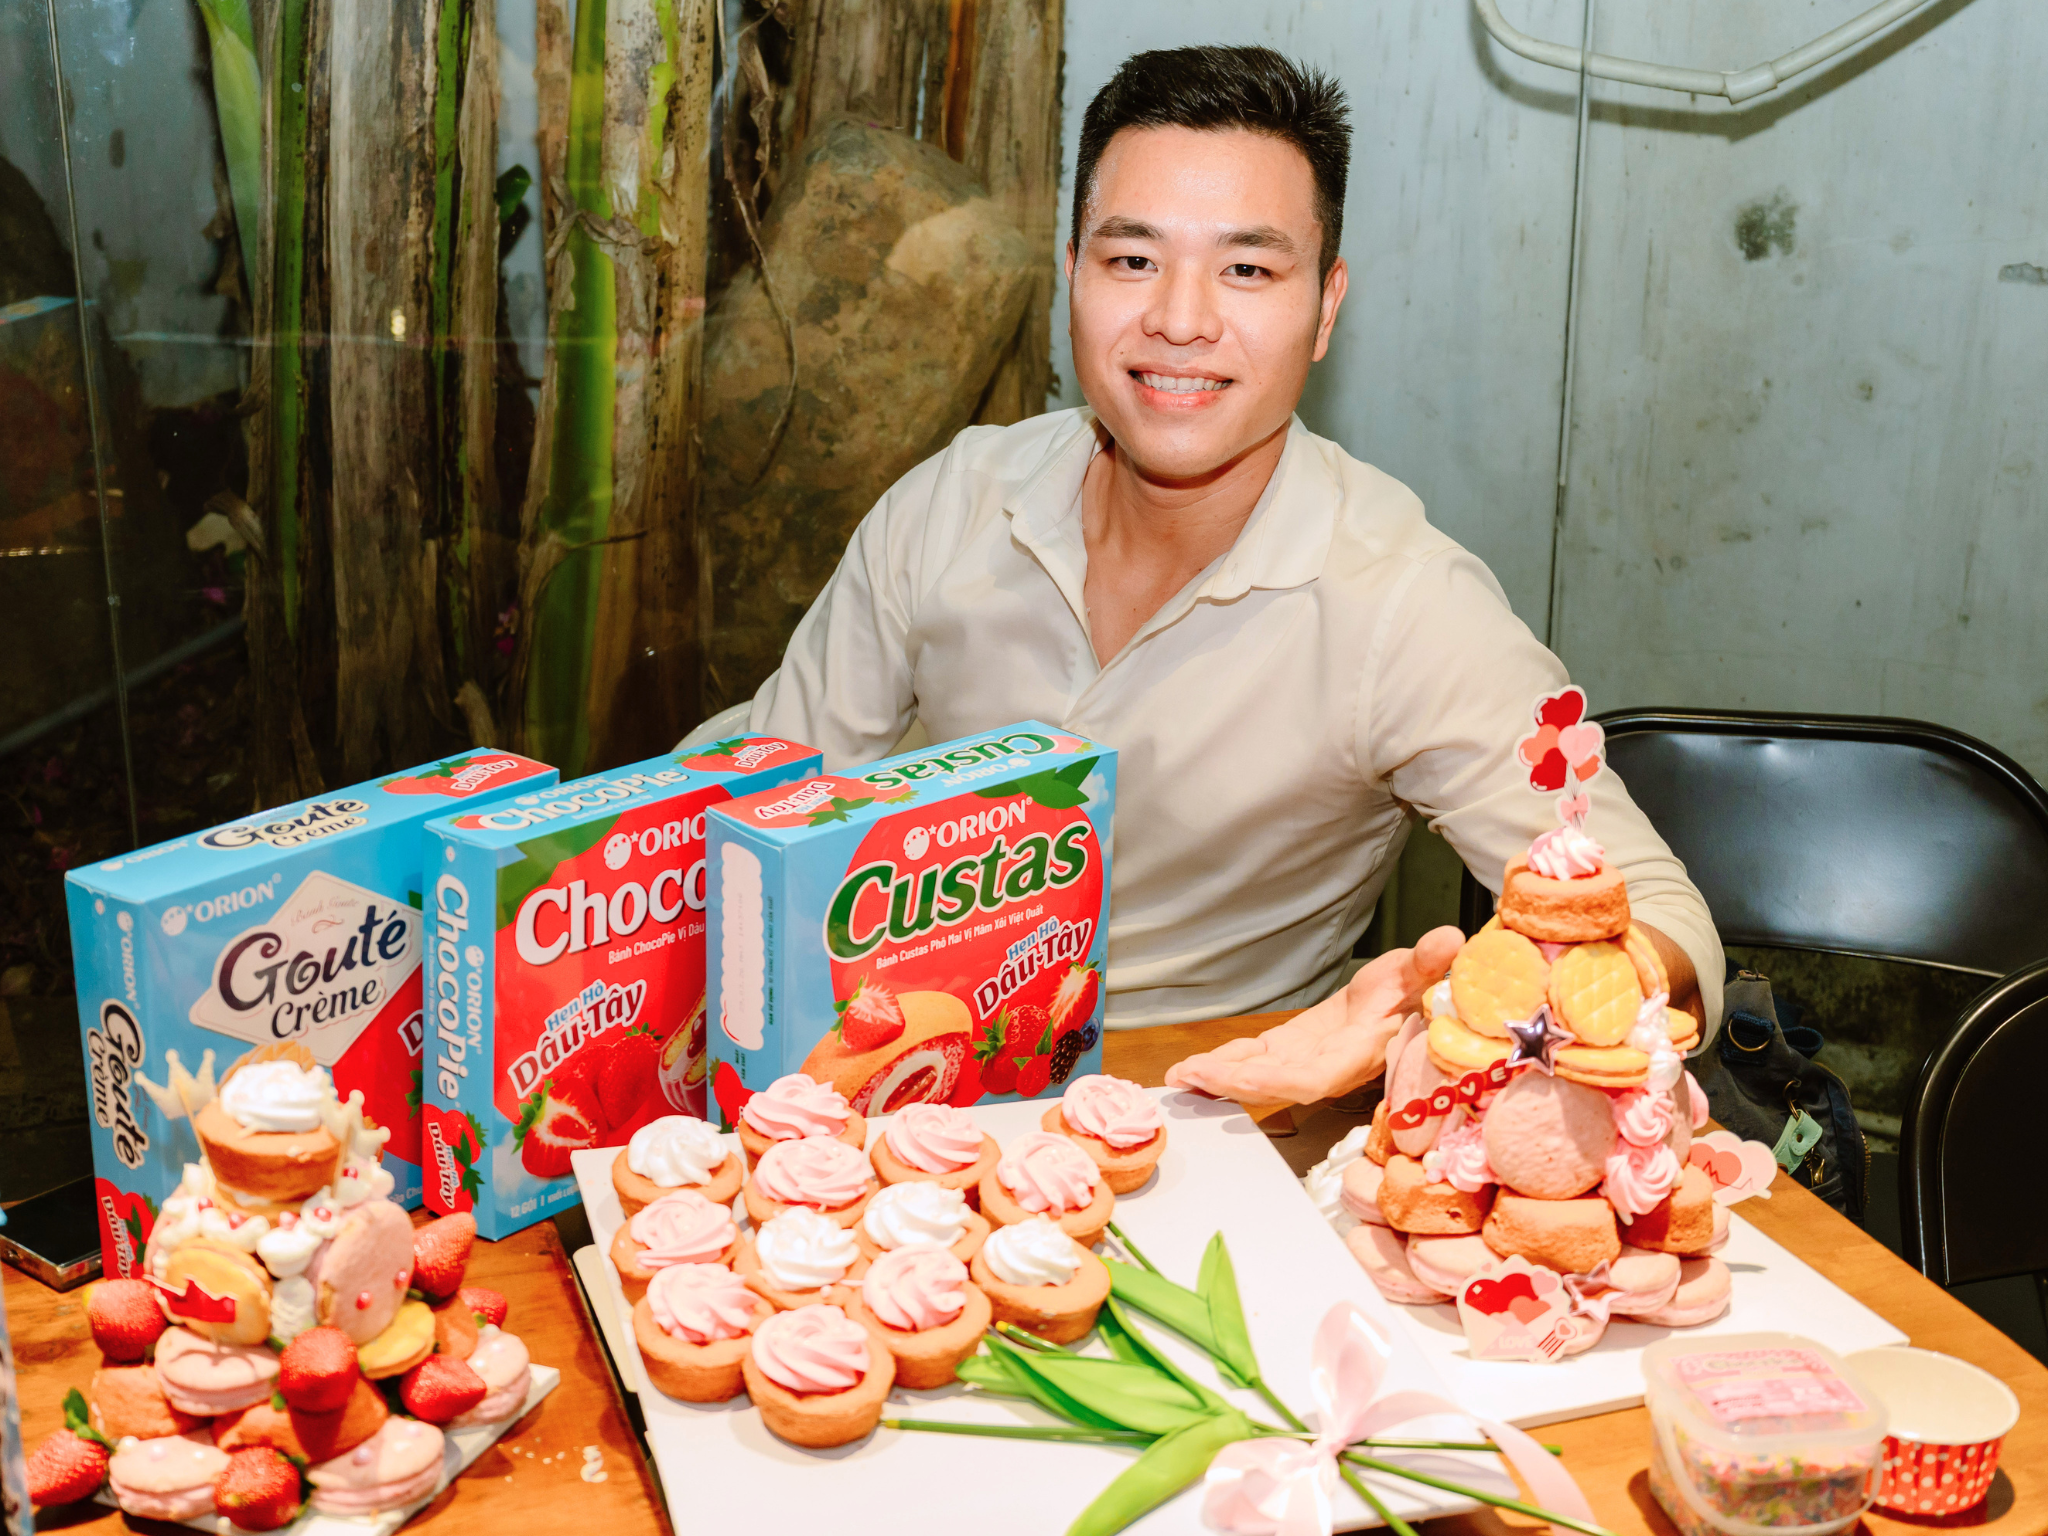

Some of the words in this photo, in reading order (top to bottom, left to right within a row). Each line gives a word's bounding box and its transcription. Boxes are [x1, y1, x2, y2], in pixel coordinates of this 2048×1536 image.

[539, 777, 606, 798] ORION
[864, 734, 1055, 788] Custas
[941, 764, 1008, 785] ORION
[204, 801, 363, 847] Gouté
[478, 771, 689, 830] ChocoPie
[937, 800, 1026, 847] ORION
[639, 812, 706, 856] ORIO
[194, 882, 274, 922] ORION
[515, 858, 706, 966] Choco
[825, 823, 1090, 960] Custas
[218, 905, 407, 1011] Gouté
[608, 946, 632, 964] Bánh
[634, 932, 675, 955] ChocoPie
[678, 926, 686, 941] Vị
[876, 954, 898, 970] Bánh
[900, 944, 929, 961] Custas
[948, 931, 962, 946] Mai
[964, 927, 973, 942] Vị
[974, 923, 993, 938] Mâm
[994, 915, 1007, 930] Xôi
[1008, 911, 1024, 926] Việt
[1026, 903, 1044, 921] Quất
[1008, 933, 1036, 960] Hẹn
[1039, 917, 1058, 939] Hò
[121, 937, 136, 1000] ORION
[436, 873, 469, 1099] ChocoPie
[466, 972, 482, 1047] ORION
[547, 1000, 579, 1032] Hẹn
[582, 982, 604, 1006] Hò
[104, 1004, 146, 1164] Gouté
